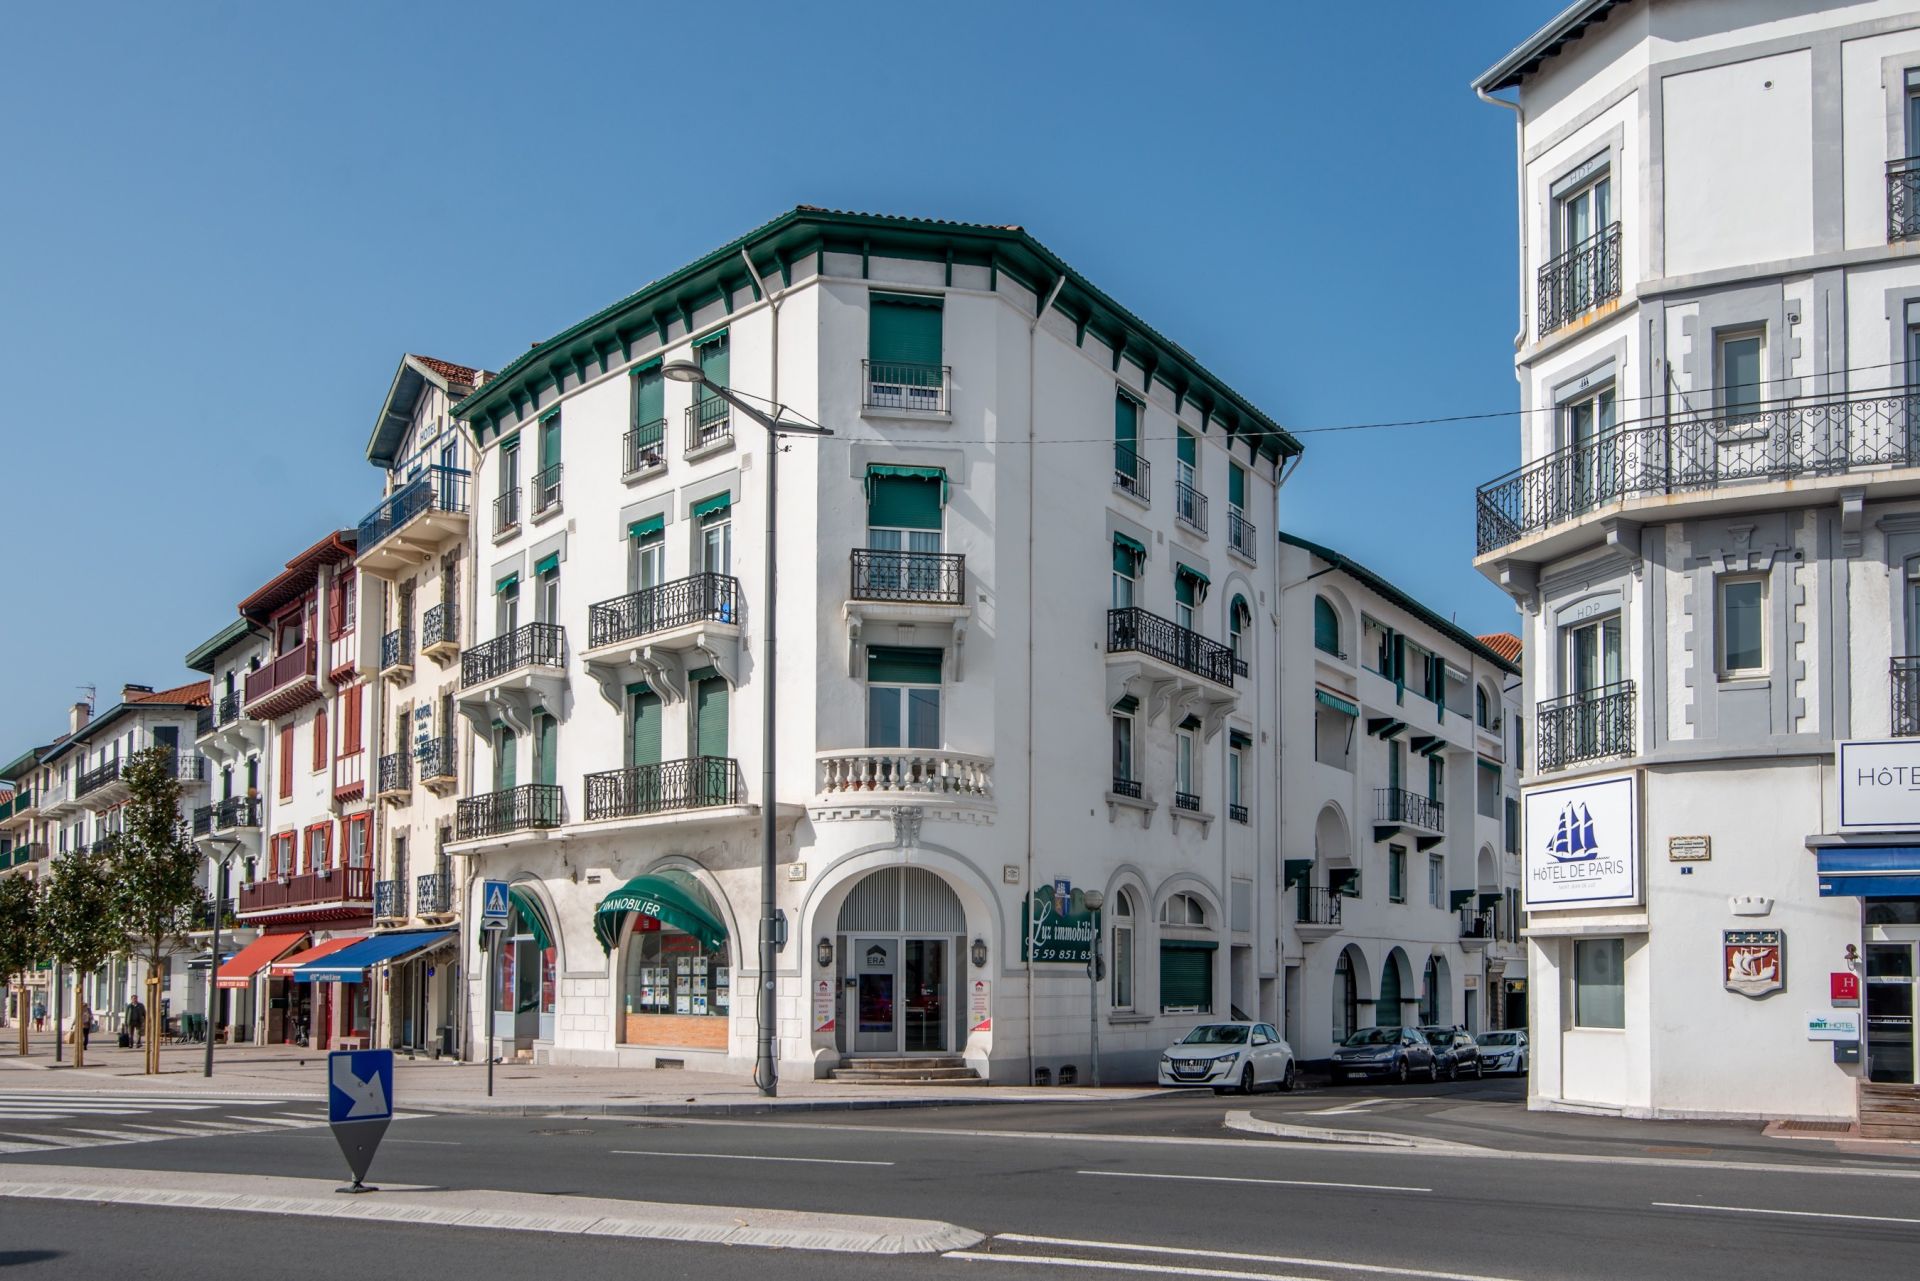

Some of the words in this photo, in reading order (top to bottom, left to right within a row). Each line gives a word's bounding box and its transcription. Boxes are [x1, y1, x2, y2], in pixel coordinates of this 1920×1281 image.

[1569, 161, 1594, 184] HDP
[1577, 602, 1600, 619] HDP
[1569, 863, 1585, 878] DE
[1588, 860, 1624, 876] PARIS
[867, 957, 885, 965] ERA
[1042, 949, 1056, 959] 59
[1058, 950, 1077, 960] 851
[1843, 977, 1855, 988] H
